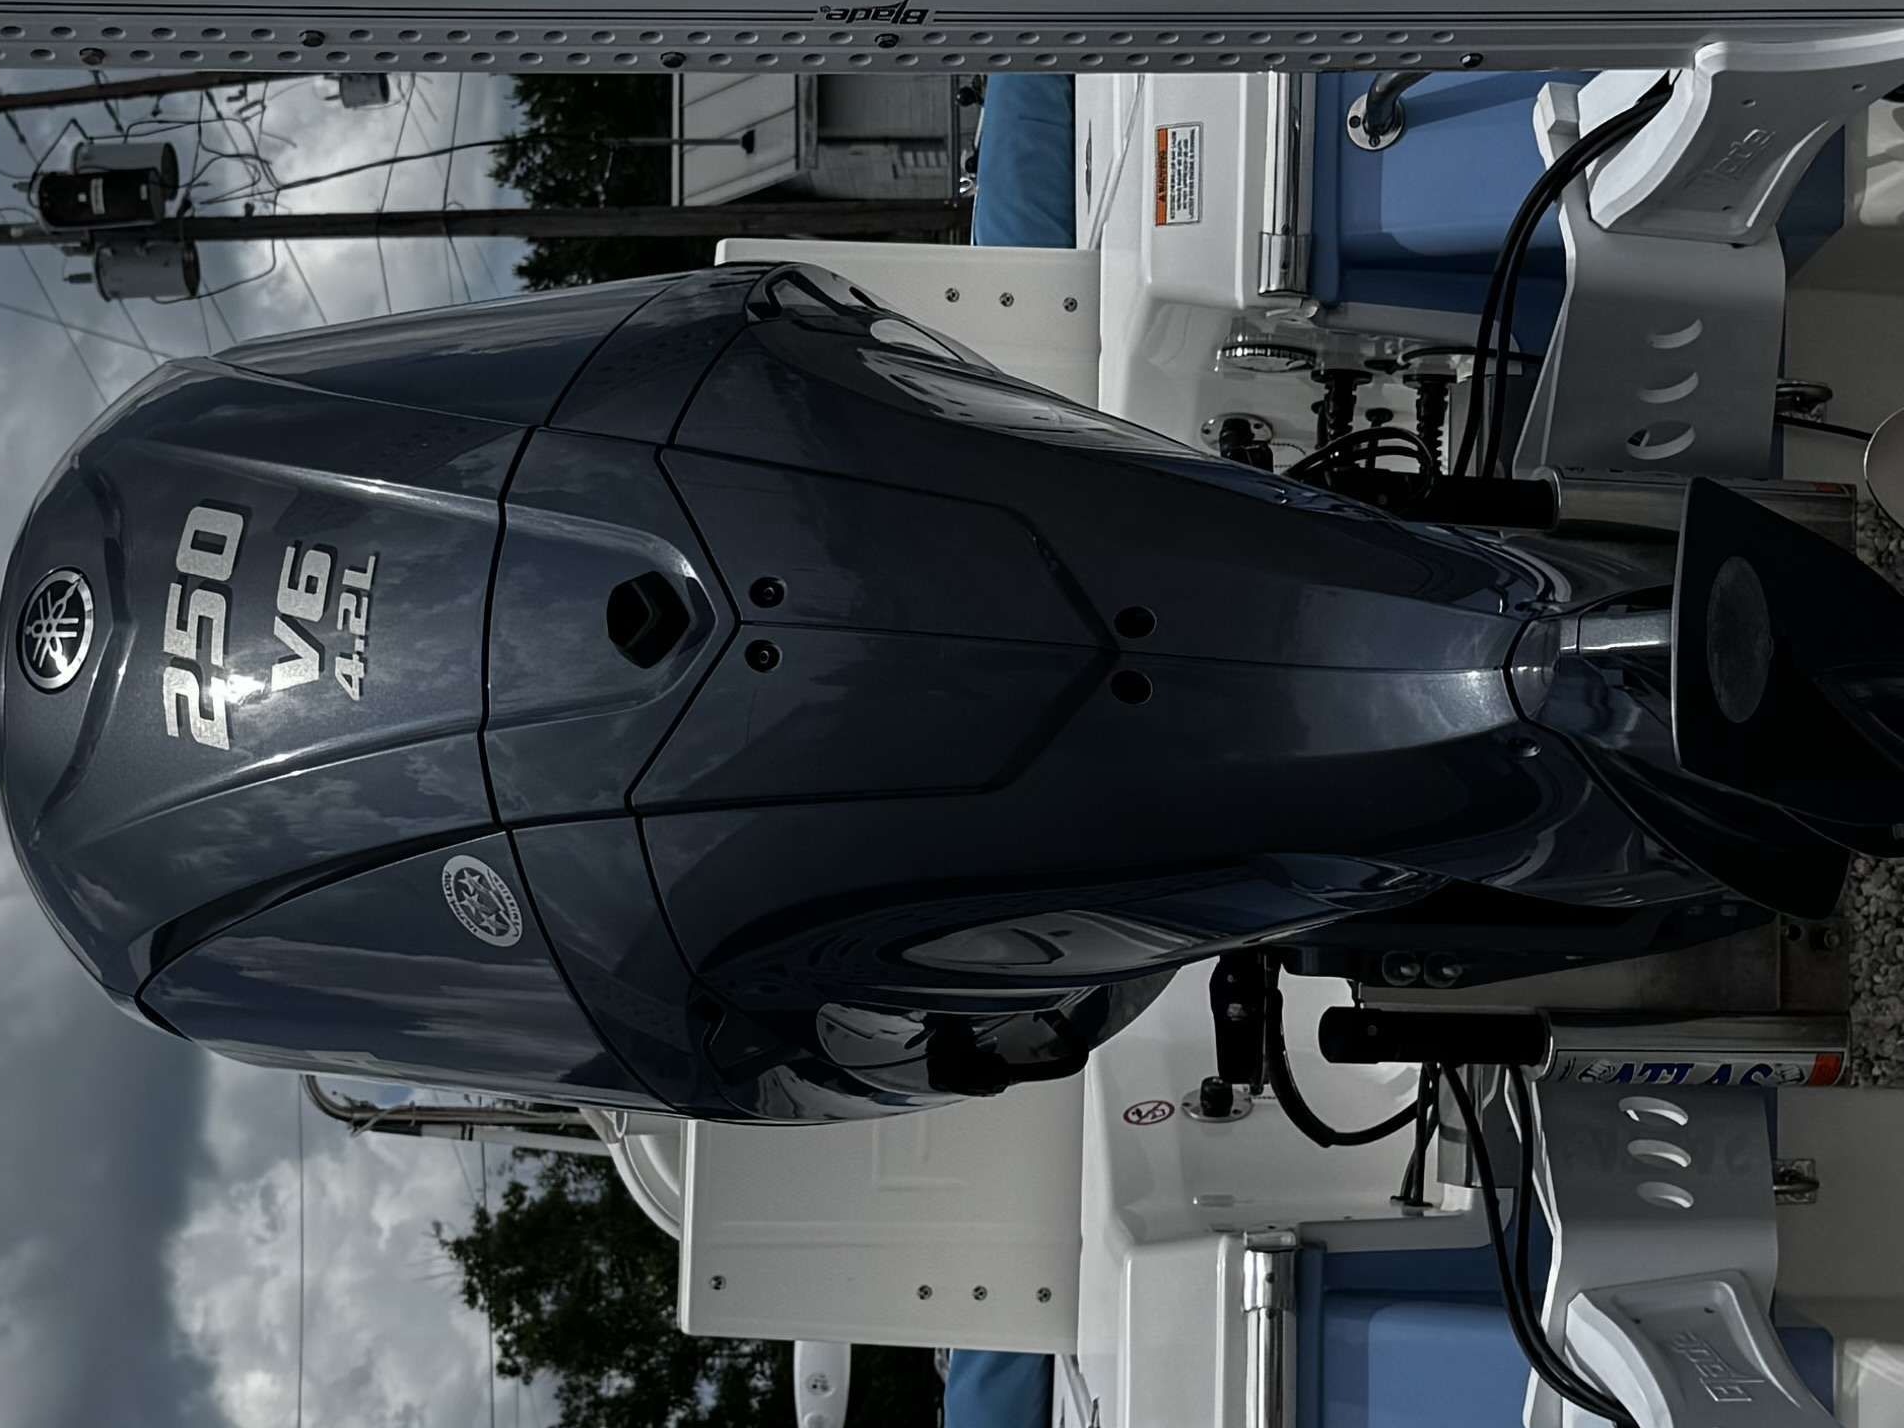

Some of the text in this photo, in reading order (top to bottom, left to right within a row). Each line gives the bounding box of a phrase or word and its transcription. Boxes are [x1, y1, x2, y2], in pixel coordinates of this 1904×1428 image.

[163, 503, 245, 751] 250
[270, 543, 333, 693] V6
[334, 554, 377, 702] 4.2L
